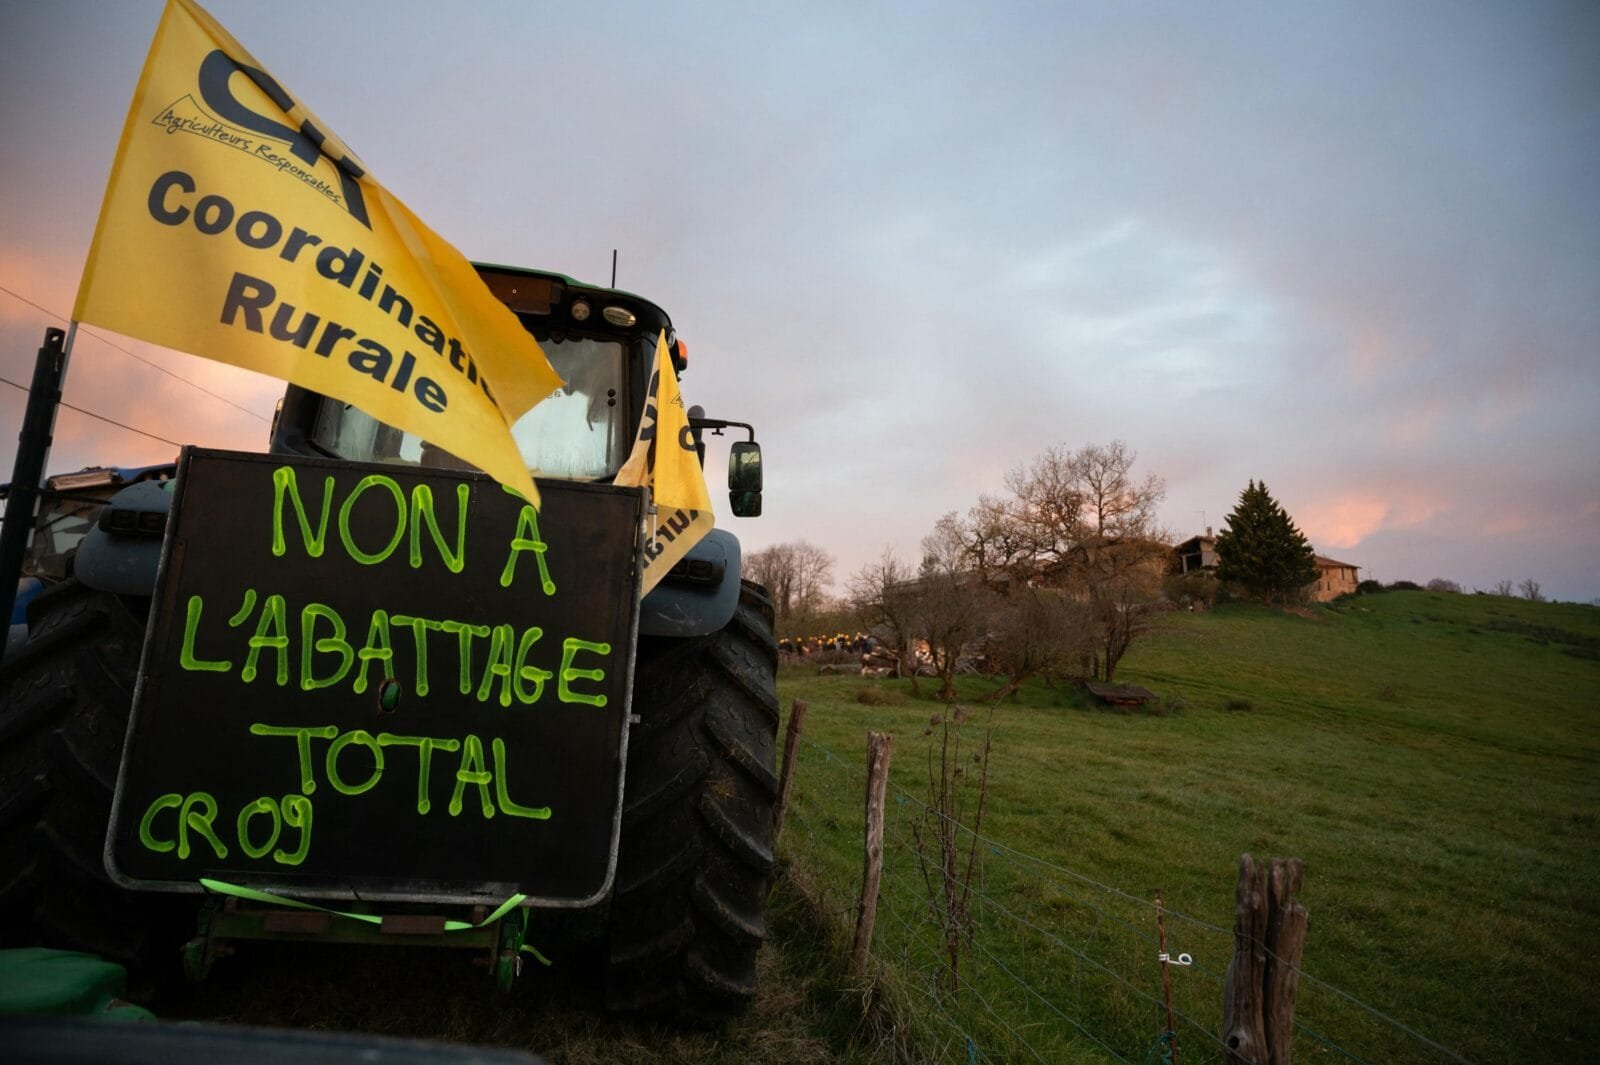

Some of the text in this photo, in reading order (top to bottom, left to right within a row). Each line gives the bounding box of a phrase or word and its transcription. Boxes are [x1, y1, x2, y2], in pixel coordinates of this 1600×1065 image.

[161, 109, 342, 203] Agriculteurs Responsables
[147, 170, 497, 406] Coordinati
[220, 272, 447, 413] Rurale
[271, 465, 471, 574] NON
[179, 588, 612, 708] L'ABATTAGE
[138, 791, 228, 860] CR
[249, 723, 552, 820] TOTAL
